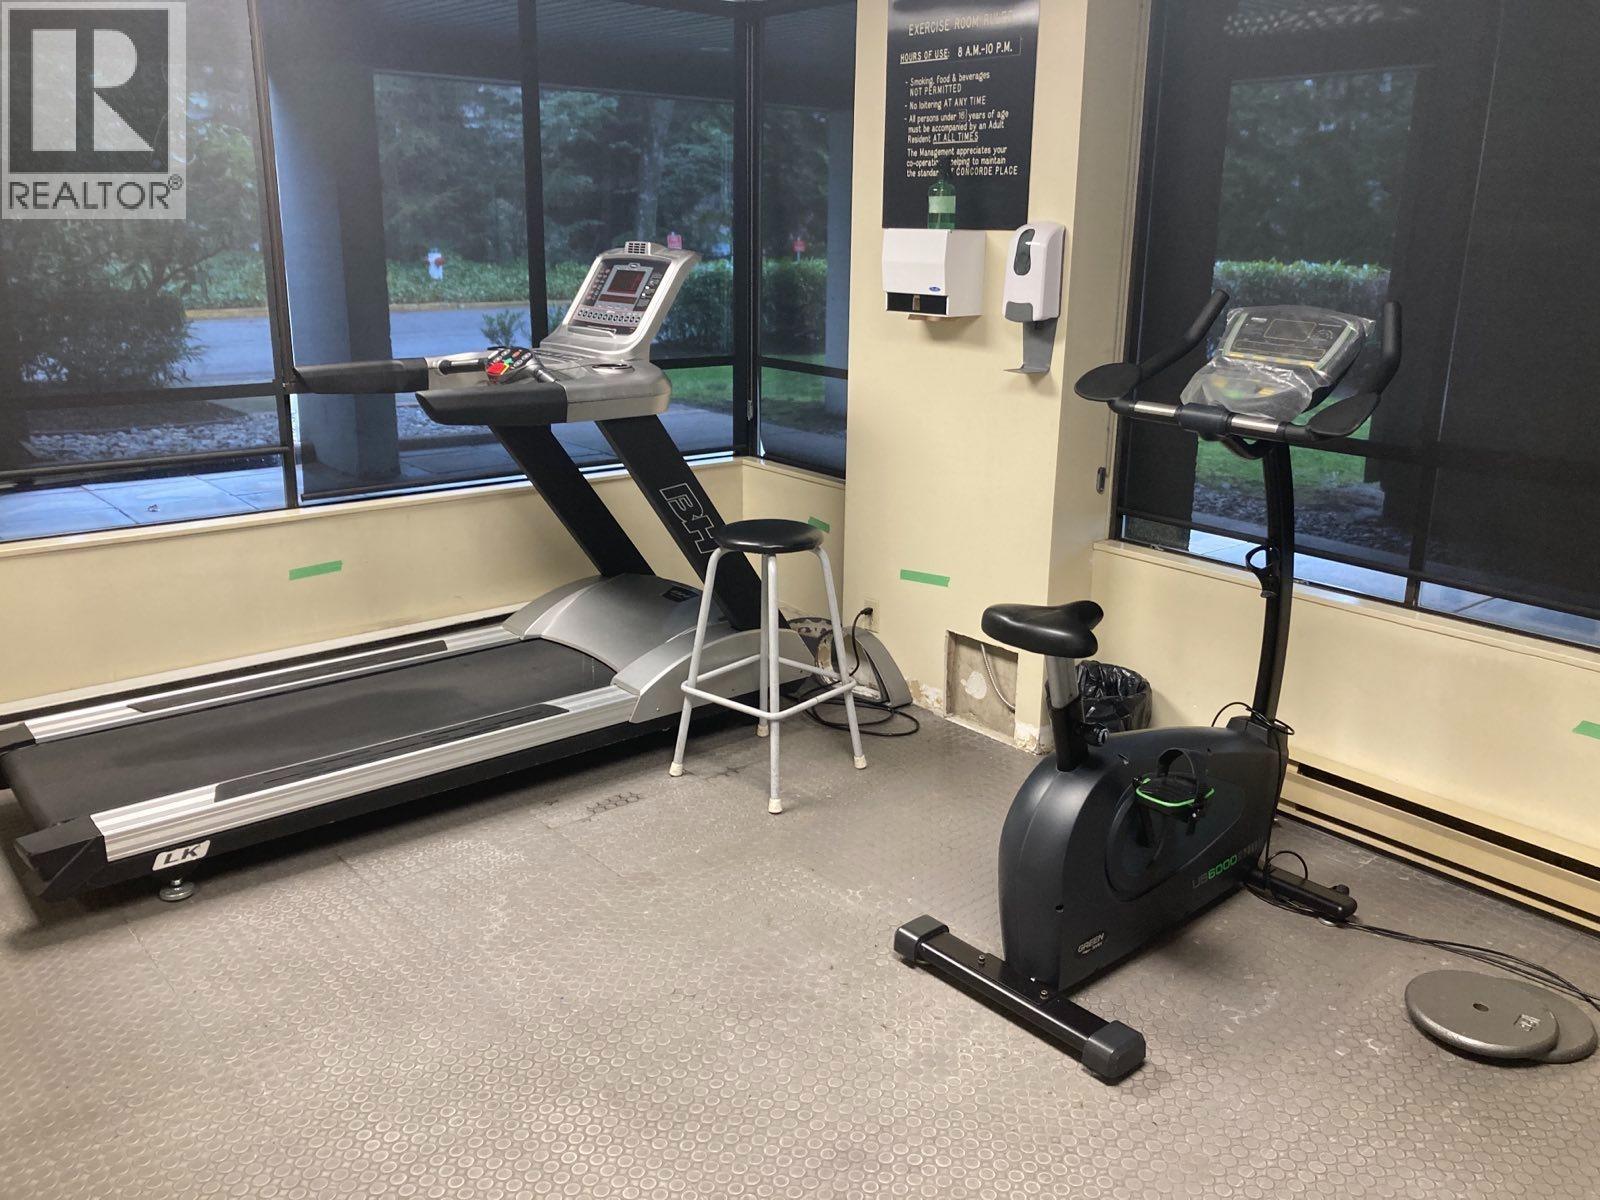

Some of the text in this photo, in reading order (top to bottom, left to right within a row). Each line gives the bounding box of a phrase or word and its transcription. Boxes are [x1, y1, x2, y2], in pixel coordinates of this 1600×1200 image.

[908, 18, 950, 36] EXERCISE
[954, 14, 979, 30] ROOM
[900, 51, 922, 63] HOURS
[924, 49, 932, 60] OF
[934, 48, 950, 60] USE:
[957, 46, 962, 58] 8
[995, 41, 1013, 54] P.M.
[936, 73, 950, 84] food
[952, 73, 956, 83] &
[958, 71, 990, 83] beverages
[910, 84, 962, 97] NOT PERMITTED
[910, 101, 918, 110] No
[944, 98, 952, 108] AT
[954, 97, 968, 106] ANY
[970, 96, 986, 105] TIME
[908, 114, 916, 123] All
[917, 115, 939, 124] persons
[940, 113, 956, 122] under
[968, 111, 986, 122] years
[988, 110, 994, 119] of
[996, 110, 1009, 120] age
[908, 120, 1004, 134] must be accompanied by an Adult
[908, 131, 979, 144] Resident AT ALL TIMES
[907, 146, 1007, 159] The Management appreciates your
[906, 158, 938, 170] co-operati
[972, 157, 980, 166] to
[980, 156, 1006, 165] maintain
[906, 168, 916, 178] the
[918, 168, 939, 178] standar
[956, 166, 993, 176] CONCORDE
[994, 165, 1018, 176] PLACE
[163, 844, 201, 865] LK
[1077, 932, 1104, 952] GREEN
